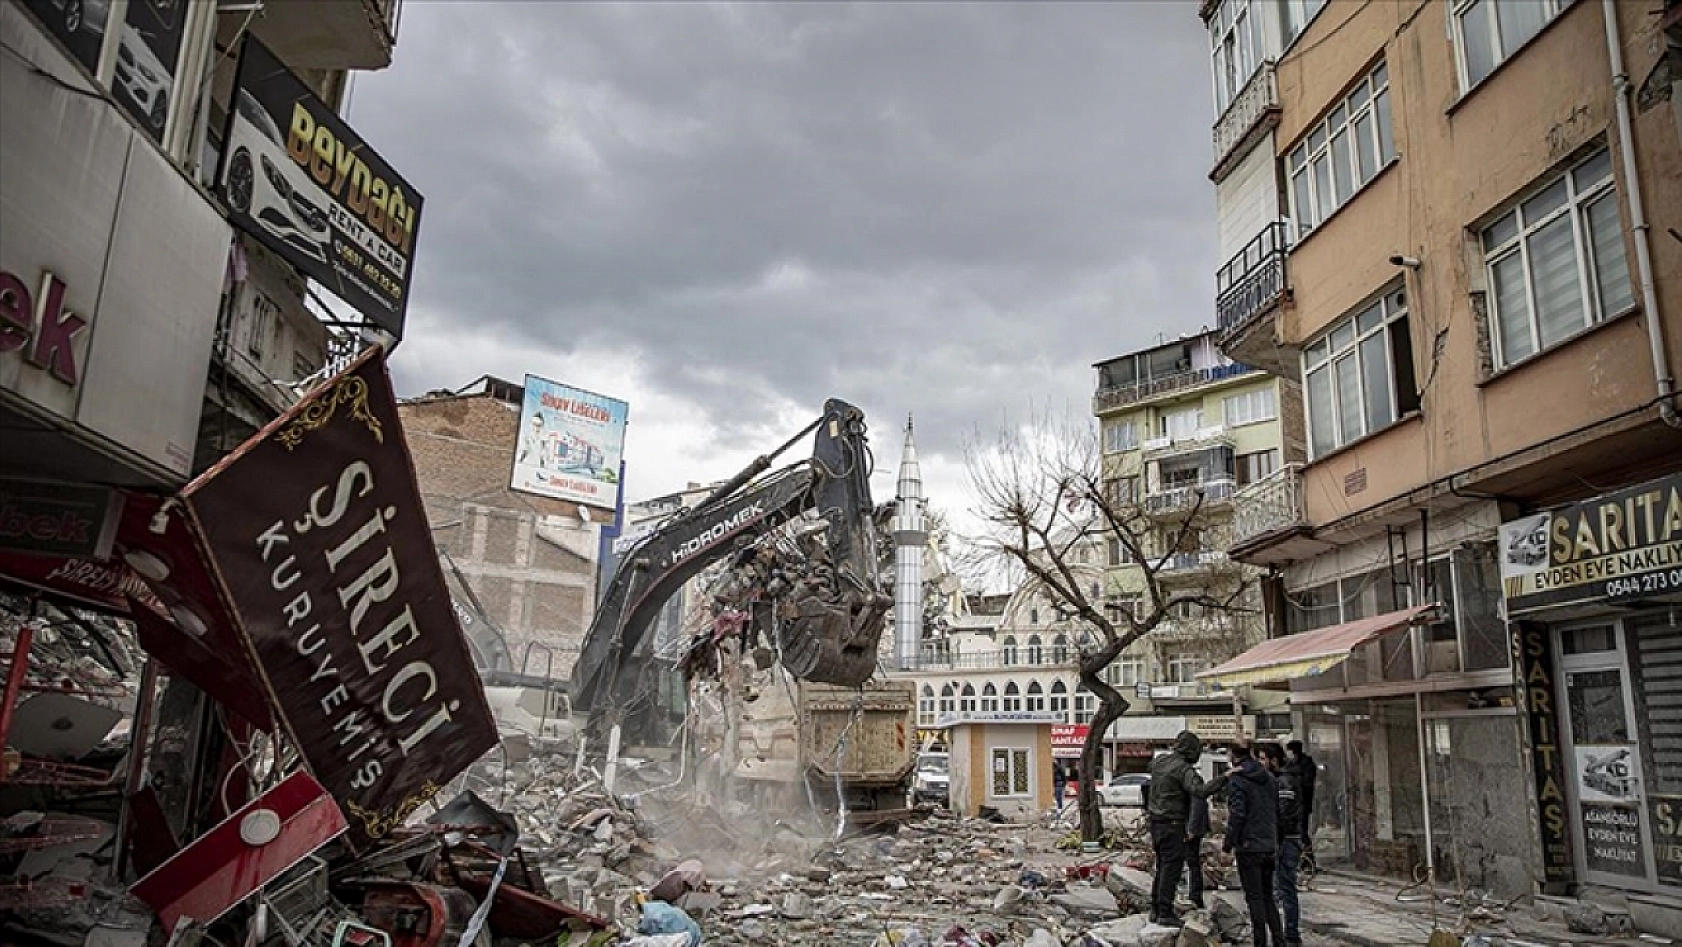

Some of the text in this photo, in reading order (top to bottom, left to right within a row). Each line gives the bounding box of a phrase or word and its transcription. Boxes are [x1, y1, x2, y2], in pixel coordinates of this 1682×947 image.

[329, 202, 364, 241] RENT
[378, 241, 403, 273] CAR
[1535, 564, 1582, 588] EVDEN
[1586, 556, 1617, 577] EVE
[1642, 571, 1668, 592] 273
[294, 460, 461, 758] ŞİRECİ
[256, 519, 385, 791] KURUYEMİŞ
